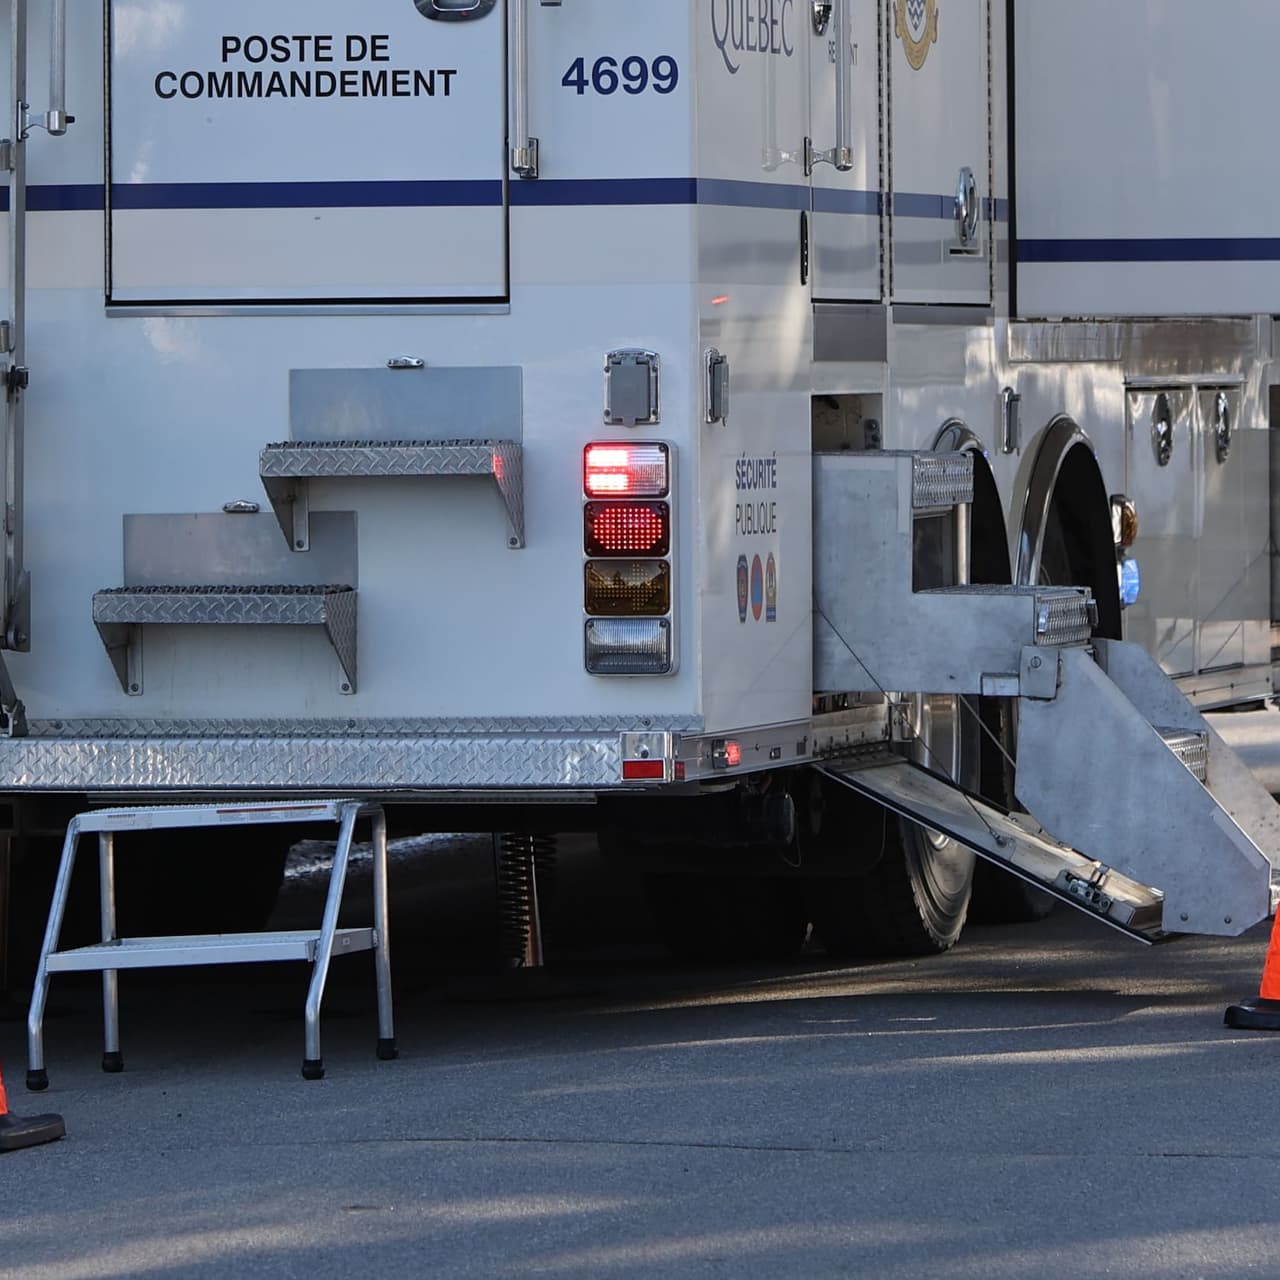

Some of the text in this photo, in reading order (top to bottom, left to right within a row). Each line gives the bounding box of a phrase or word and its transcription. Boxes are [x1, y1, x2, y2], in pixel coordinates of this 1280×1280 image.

[220, 34, 391, 63] POSTE DE
[154, 68, 458, 100] COMMANDEMENT
[561, 54, 679, 96] 4699
[735, 450, 777, 490] SÉCURITÉ
[735, 501, 777, 536] PUBLIQUE
